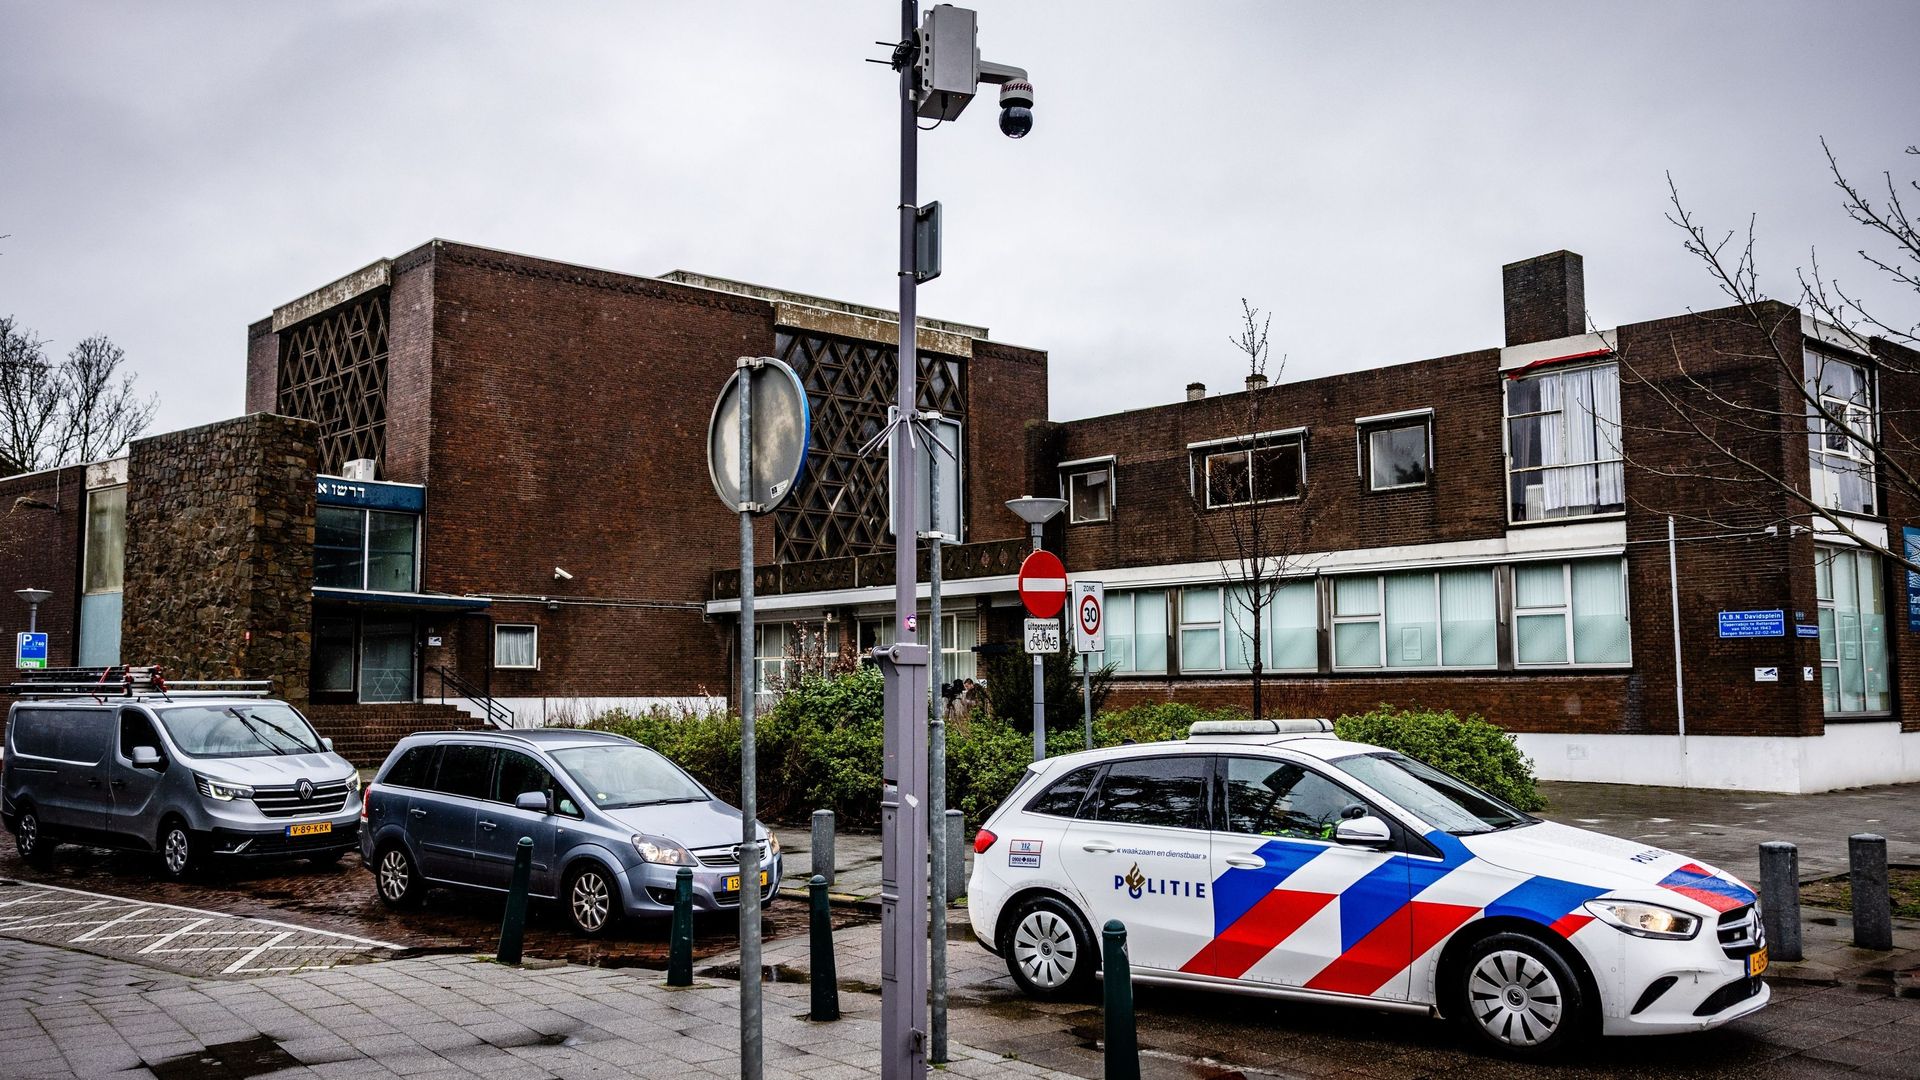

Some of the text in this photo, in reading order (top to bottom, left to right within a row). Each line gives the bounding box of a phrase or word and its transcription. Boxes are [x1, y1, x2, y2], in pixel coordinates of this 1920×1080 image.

[331, 484, 365, 498] דרשו
[1084, 607, 1097, 622] 30
[1028, 622, 1058, 632] uitgezonderd
[23, 634, 32, 646] P
[292, 823, 330, 835] V-89-KRK
[1121, 847, 1156, 856] waakzaam
[1166, 850, 1202, 859] dienstbaar
[1114, 873, 1206, 899] POLITIE
